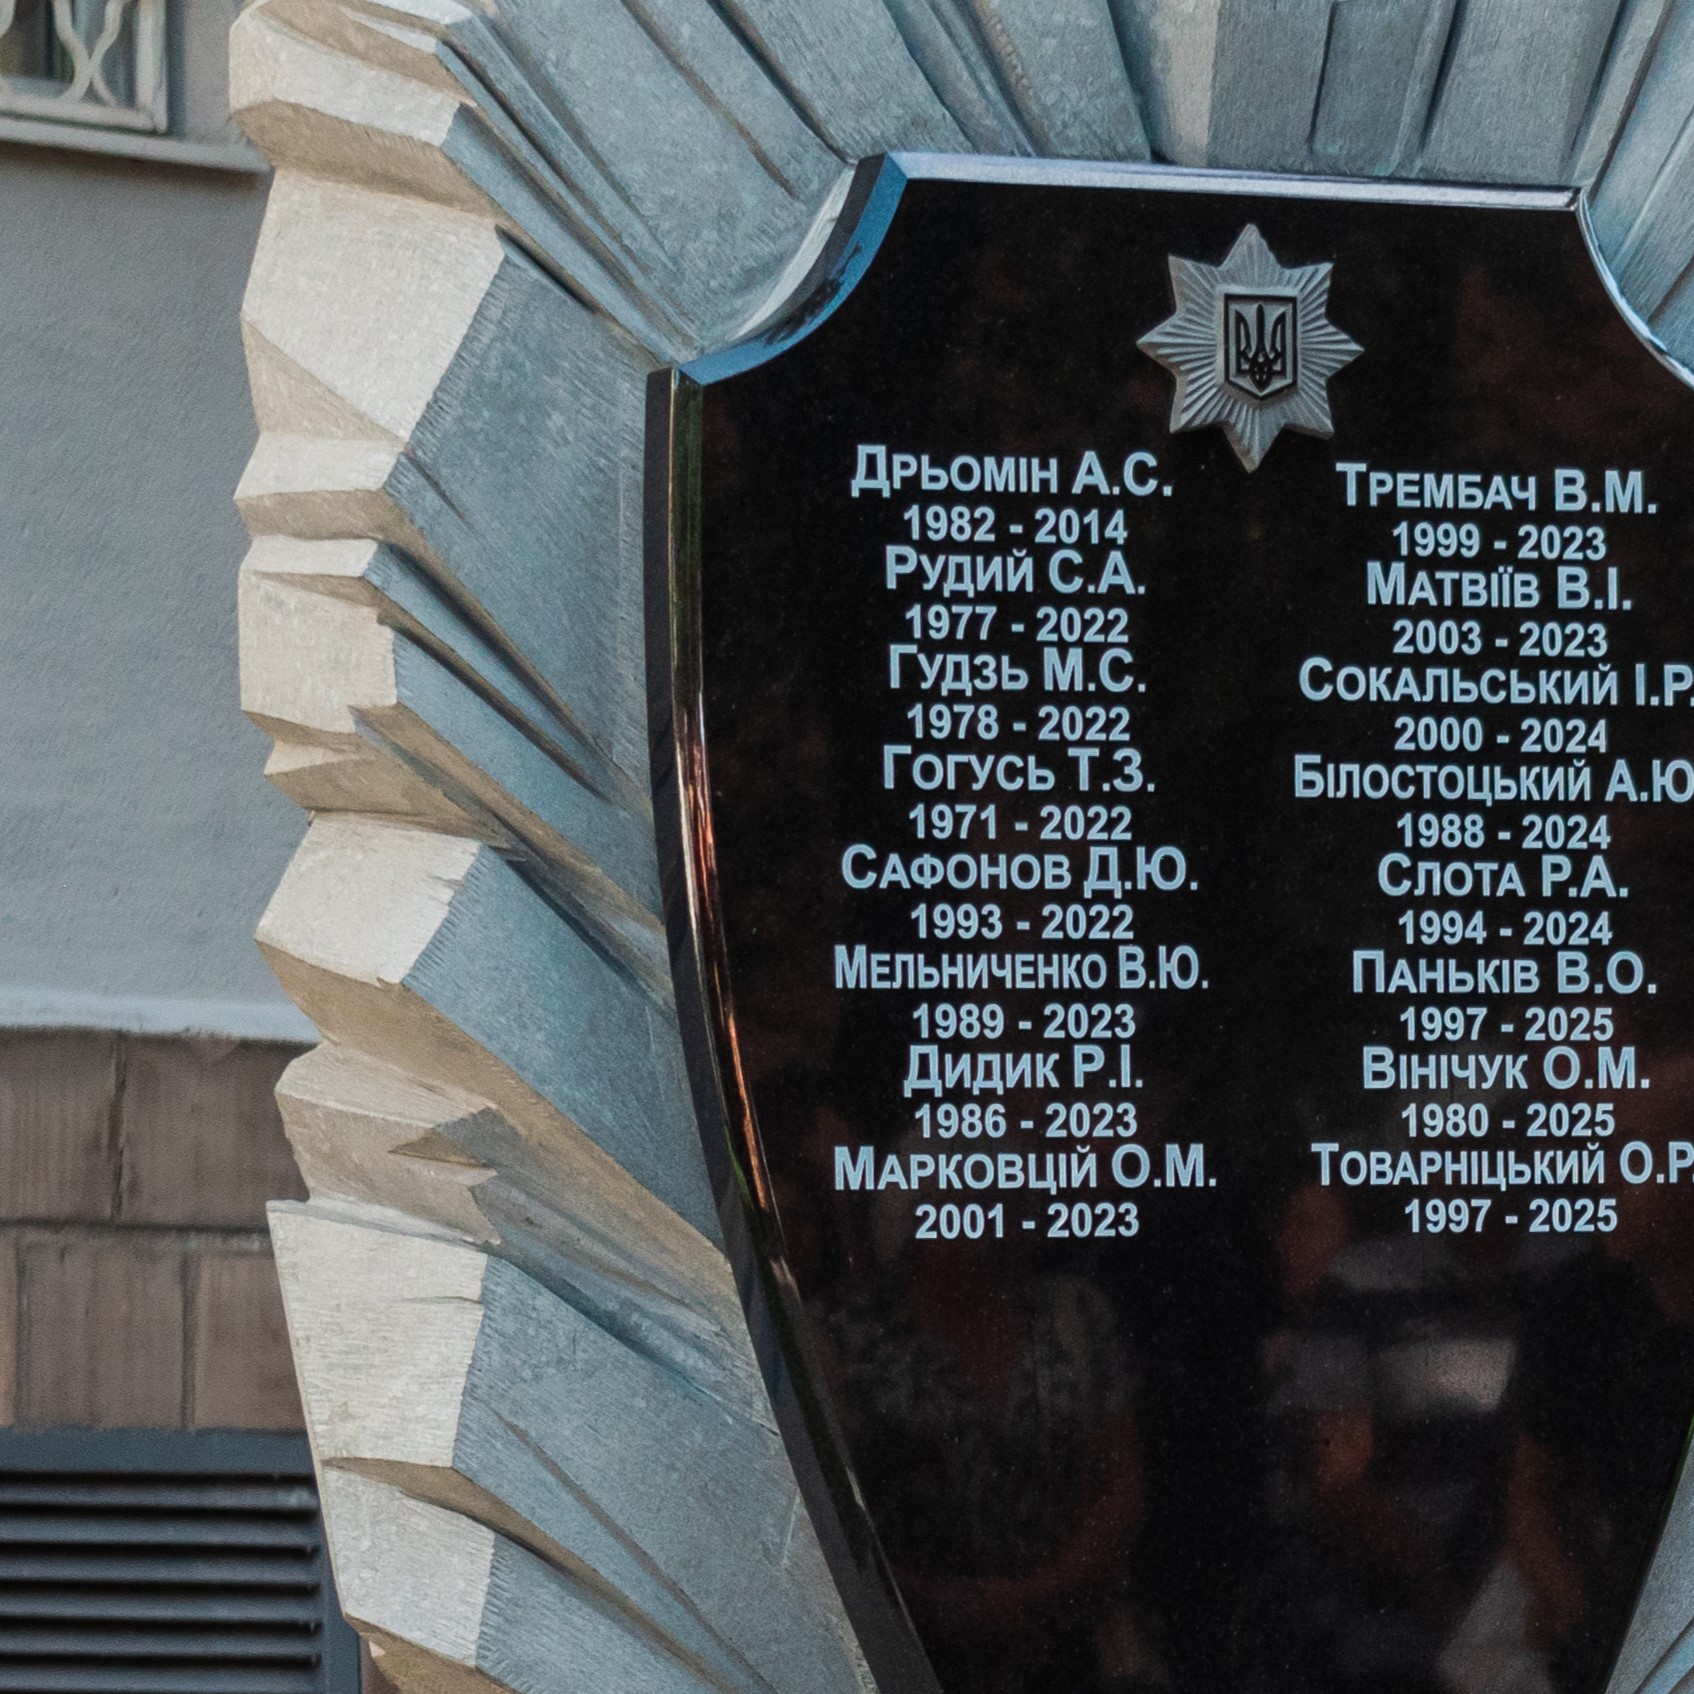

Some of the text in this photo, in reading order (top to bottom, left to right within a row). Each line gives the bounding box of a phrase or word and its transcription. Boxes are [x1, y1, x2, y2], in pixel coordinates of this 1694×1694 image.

[850, 443, 1059, 499] ДРЬОМІН
[1335, 461, 1537, 511] ТРЕМБАЧ
[903, 503, 996, 543] 1982
[1034, 506, 1129, 546] 2014
[1392, 520, 1481, 559] 1999
[1517, 523, 1607, 561] 2023
[885, 544, 1034, 599] РУДИЙ
[1366, 560, 1541, 609] МАТВІЇВ
[905, 603, 998, 641] 1977
[1036, 605, 1130, 644] 2022
[1392, 618, 1483, 656] 2003
[1519, 620, 1608, 658] 2023
[889, 643, 1029, 697] ГУДЗЬ
[1298, 655, 1618, 706] СОКАЛЬСЬКИЙ
[906, 702, 1000, 741] 1978
[1037, 704, 1131, 742] 2022
[1394, 715, 1484, 752] 2000
[1520, 717, 1608, 754] 2024
[882, 743, 1056, 792] ГОГУСЬ
[1294, 753, 1592, 808] БІЛОСТОЦЬКИЙ
[908, 802, 997, 840] 1971
[1039, 804, 1133, 841] 2022
[1396, 811, 1486, 849] 1988
[1521, 813, 1612, 850] 2024
[841, 843, 1072, 890] САФОНОВ
[1377, 851, 1526, 898] СЛОТА
[910, 902, 1003, 940] 1993
[1041, 903, 1135, 940] 2022
[1398, 909, 1488, 946] 1994
[1523, 910, 1614, 946] 2024
[833, 943, 1108, 990] МЕЛЬНИЧЕНКО
[1352, 948, 1541, 994] ПАНЬКІВ
[912, 1002, 1005, 1040] 1989
[1043, 1002, 1137, 1040] 2023
[1399, 1005, 1488, 1042] 1997
[1524, 1005, 1615, 1042] 2025
[902, 1044, 1060, 1099] ДИДИК
[1362, 1044, 1529, 1090] ВІНІЧУК
[914, 1102, 1008, 1139] 1986
[1045, 1101, 1138, 1138] 2023
[1401, 1102, 1490, 1138] 1980
[1525, 1101, 1616, 1138] 2025
[833, 1144, 1098, 1196] МАРКОВЦІЙ
[1310, 1141, 1605, 1192] ТОВАРНІЦЬКИЙ
[914, 1202, 1004, 1240] 2001
[1046, 1201, 1140, 1238] 2023
[1404, 1197, 1492, 1234] 1997
[1528, 1197, 1618, 1233] 2025
